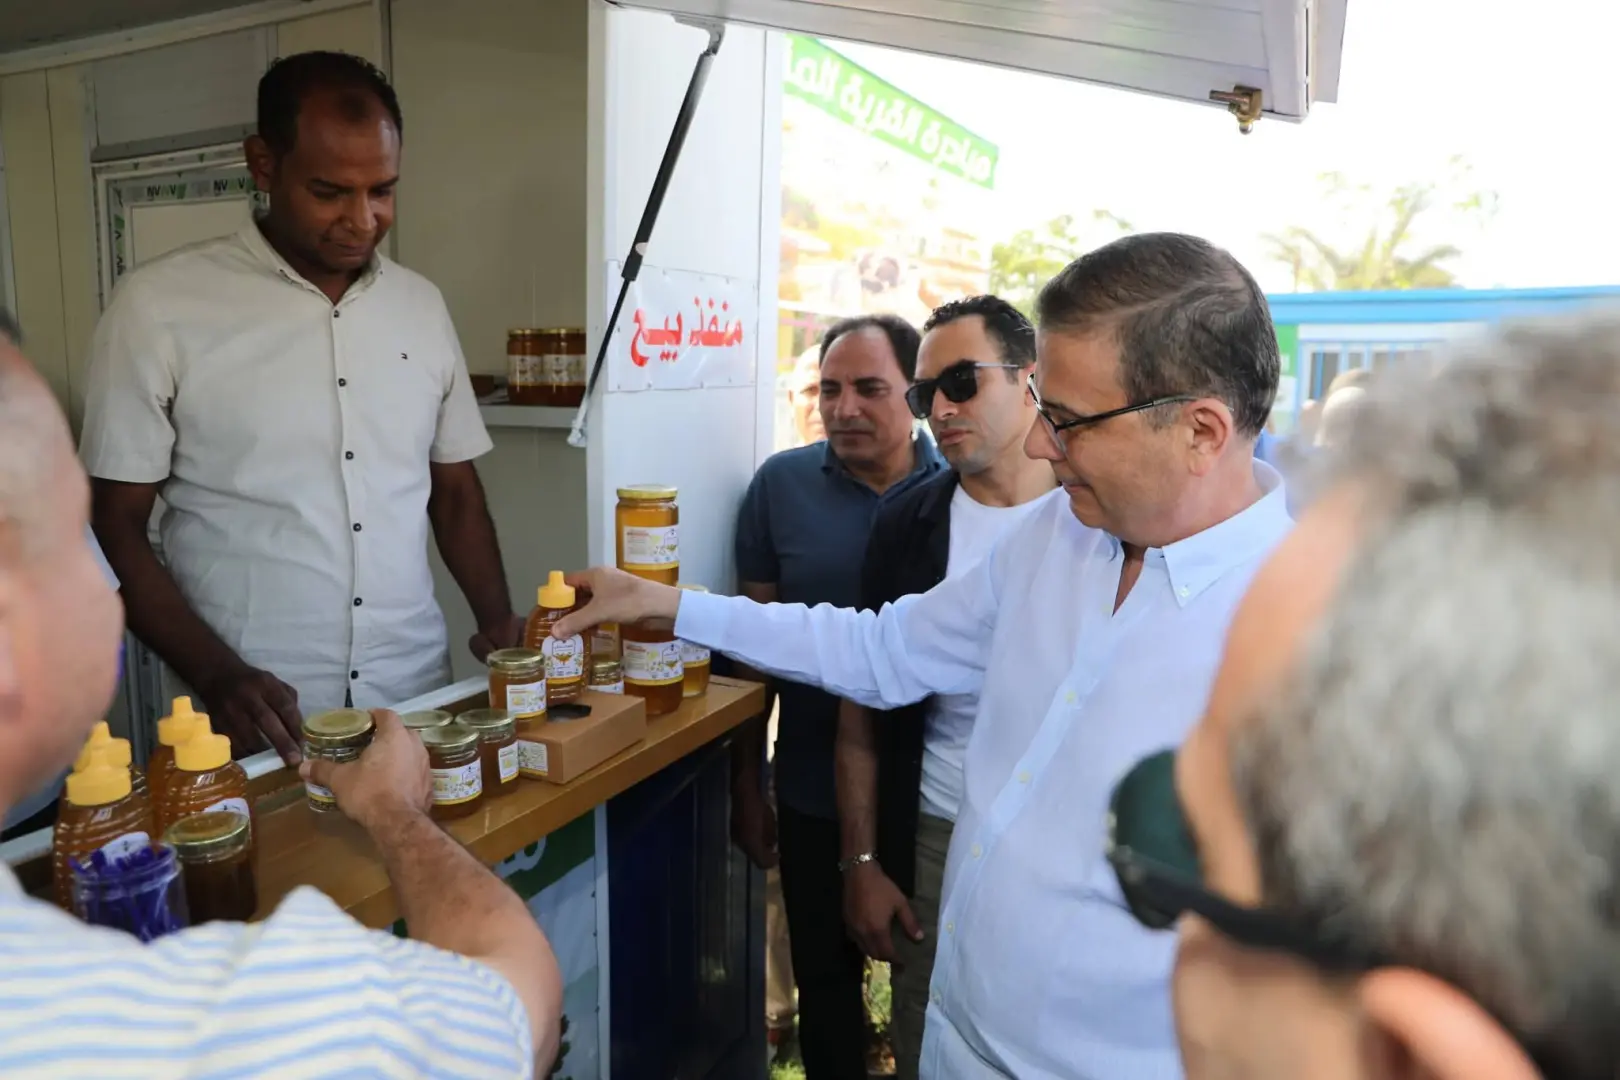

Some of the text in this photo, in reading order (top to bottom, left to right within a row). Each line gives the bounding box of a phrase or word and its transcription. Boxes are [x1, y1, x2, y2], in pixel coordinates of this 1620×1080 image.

[840, 73, 923, 144] القرية
[920, 119, 991, 182] مبادرة
[630, 296, 743, 367] منفذ بيع
